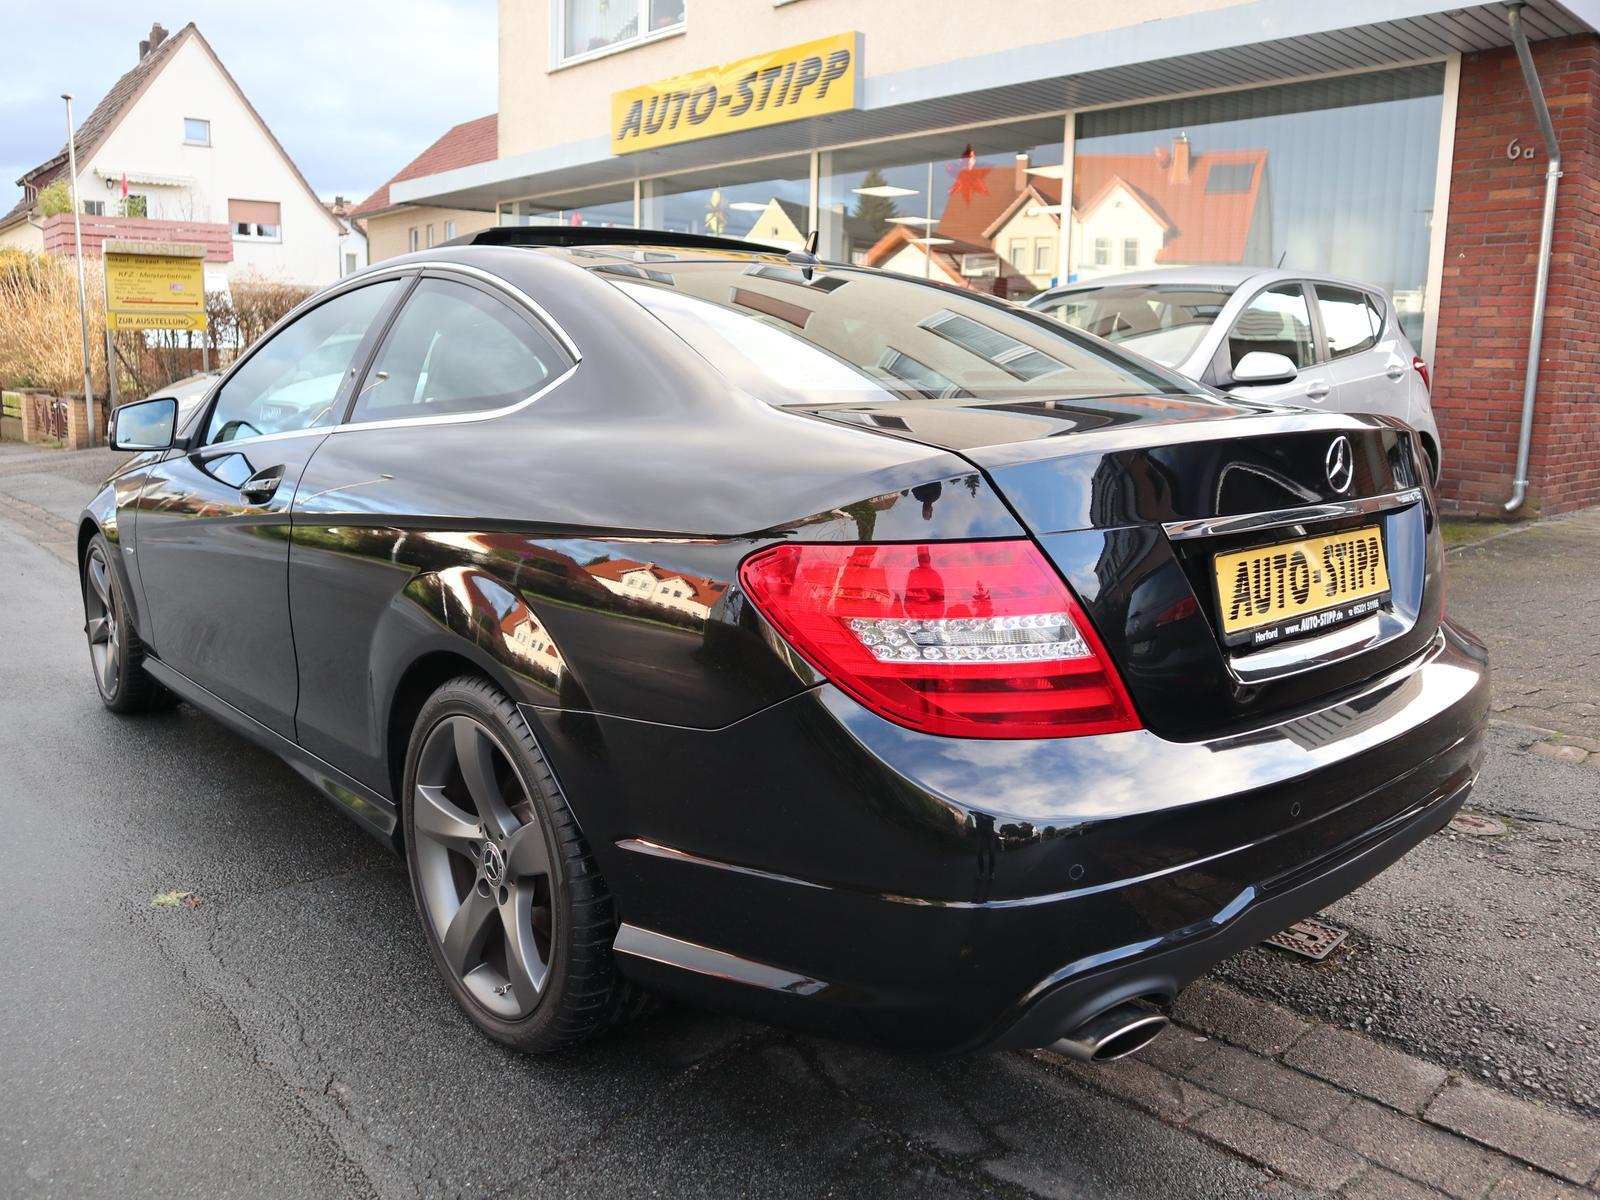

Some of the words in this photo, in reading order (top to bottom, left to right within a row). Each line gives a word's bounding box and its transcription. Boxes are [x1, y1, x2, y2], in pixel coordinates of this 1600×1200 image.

[616, 49, 851, 141] AUTO-STIPP
[1507, 138, 1535, 159] 6a
[139, 271, 193, 280] Meisterbetrieb
[118, 317, 133, 325] ZUR
[135, 317, 190, 326] AUSSTELLUNG
[1229, 537, 1379, 620] AUTO-STIPP
[1255, 627, 1279, 643] Herford
